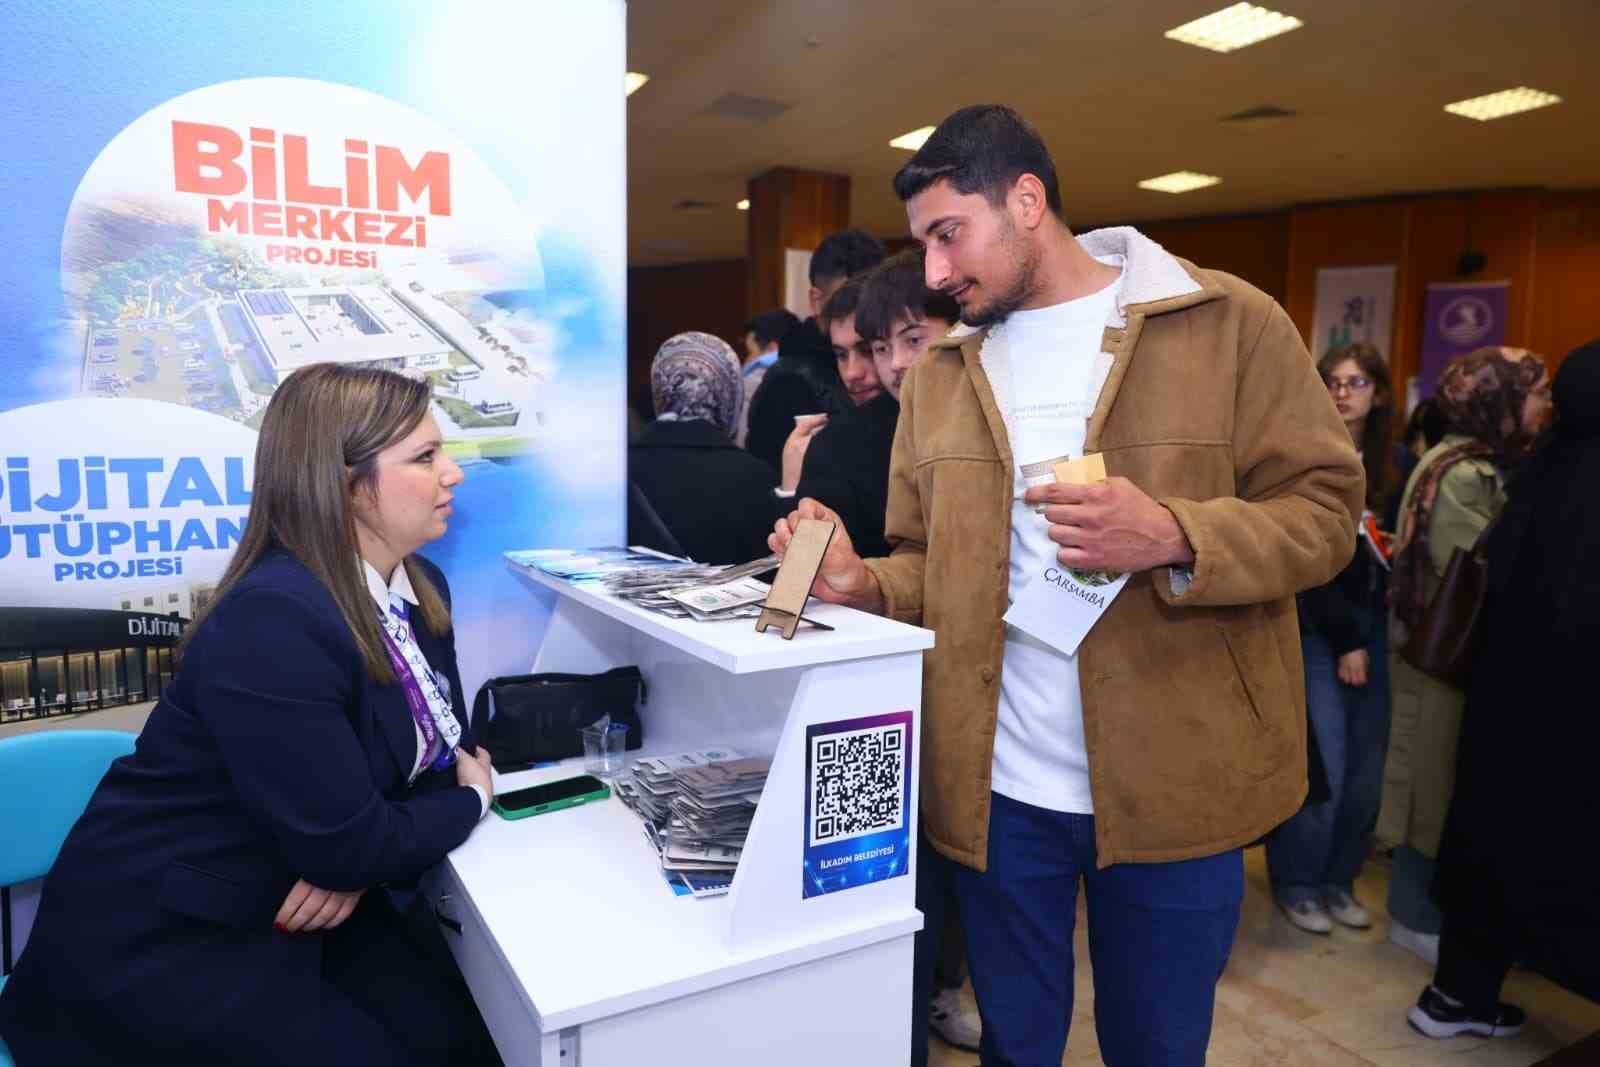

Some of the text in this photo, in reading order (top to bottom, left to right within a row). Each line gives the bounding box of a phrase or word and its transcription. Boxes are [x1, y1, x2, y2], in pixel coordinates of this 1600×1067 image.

[0, 456, 253, 512] İJİTAL
[820, 844, 895, 869] İLKADIM BELEDİYESİ
